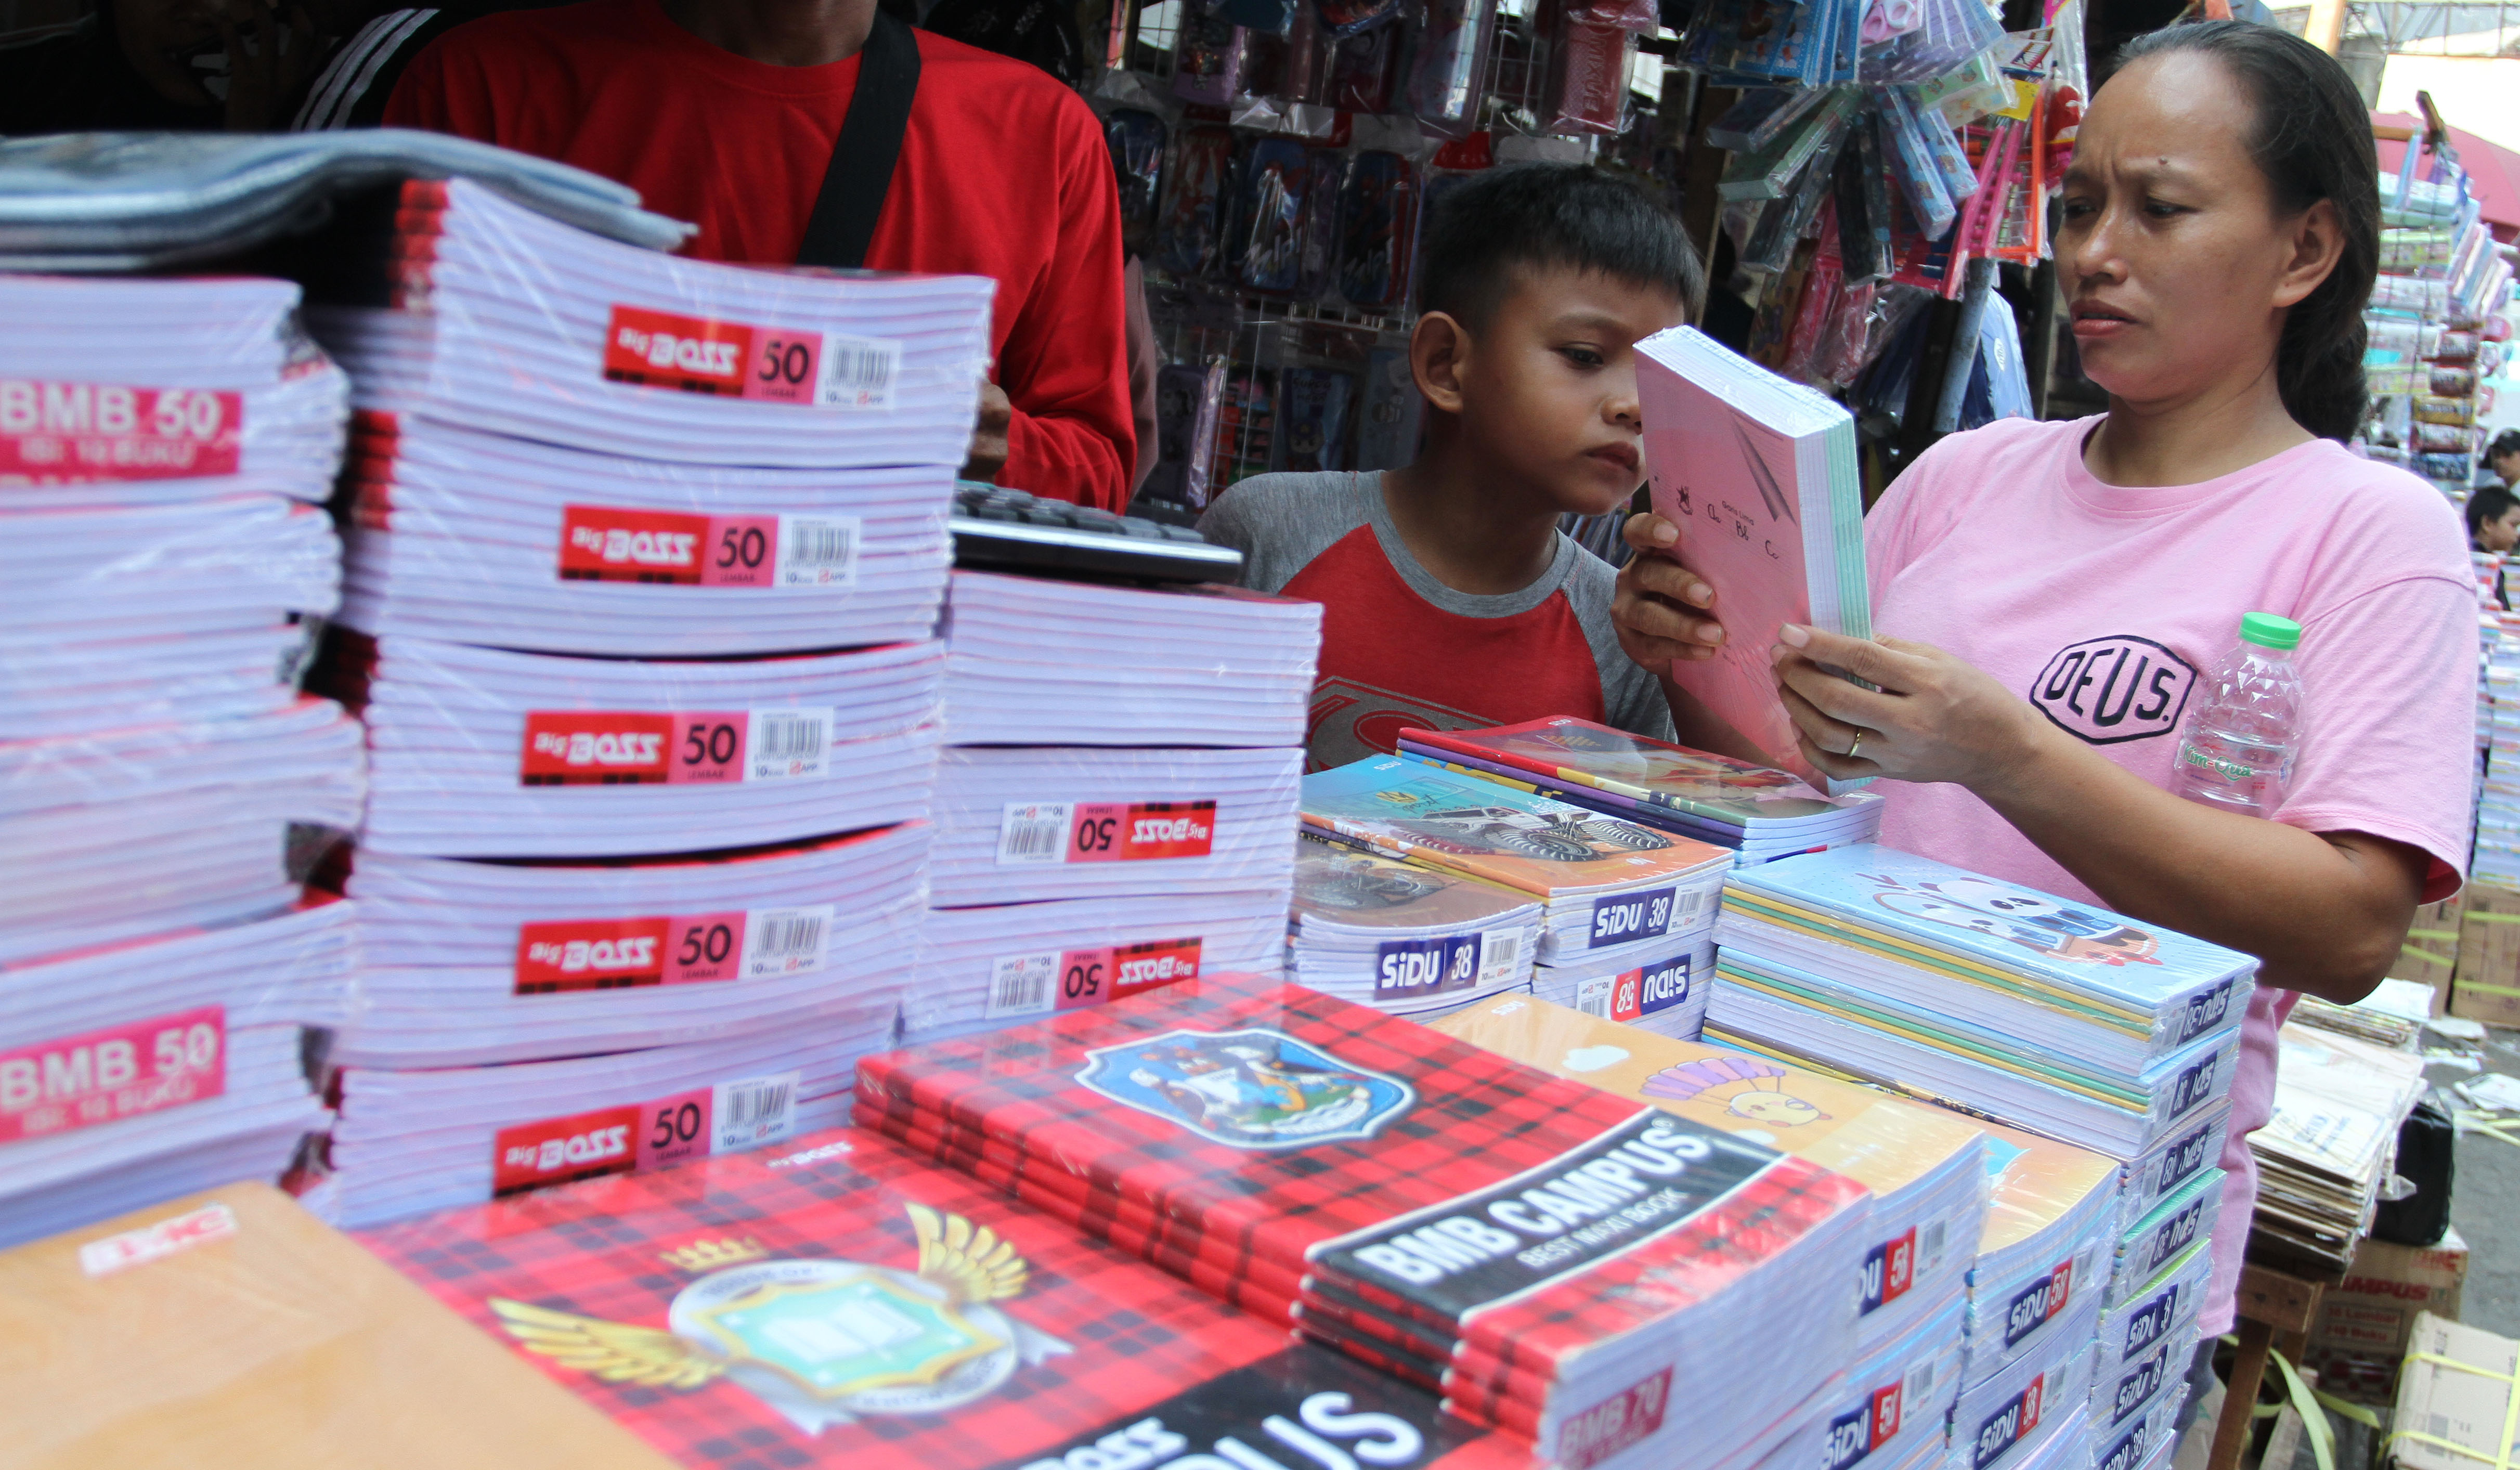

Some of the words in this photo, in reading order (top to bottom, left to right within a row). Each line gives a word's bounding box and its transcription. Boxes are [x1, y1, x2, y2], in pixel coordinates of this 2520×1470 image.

[758, 340, 809, 384] 50
[0, 380, 137, 435] BMB
[156, 388, 222, 440] 50
[717, 527, 765, 569] 50
[683, 724, 736, 764] 50
[1077, 818, 1116, 853] 50
[1594, 902, 1644, 938] SiDU
[1648, 896, 1669, 928] 38
[678, 924, 732, 966] 50
[1381, 949, 1440, 988] SiDU
[1451, 944, 1474, 981] 38
[1064, 964, 1103, 998] 50
[1616, 980, 1635, 1013] 58
[1643, 965, 1686, 1004] SiDU
[0, 1040, 137, 1110] BMB
[155, 1022, 217, 1075] 50
[651, 1102, 701, 1149] 50
[1353, 1216, 1522, 1285] BMB
[1487, 1126, 1712, 1235] CAMPUS
[1570, 1209, 1623, 1244] MAXI
[1620, 1186, 1691, 1222] BOOK
[2008, 1285, 2050, 1338] SiDU
[1977, 1404, 2018, 1461] SiDU
[2131, 1427, 2144, 1461] 38
